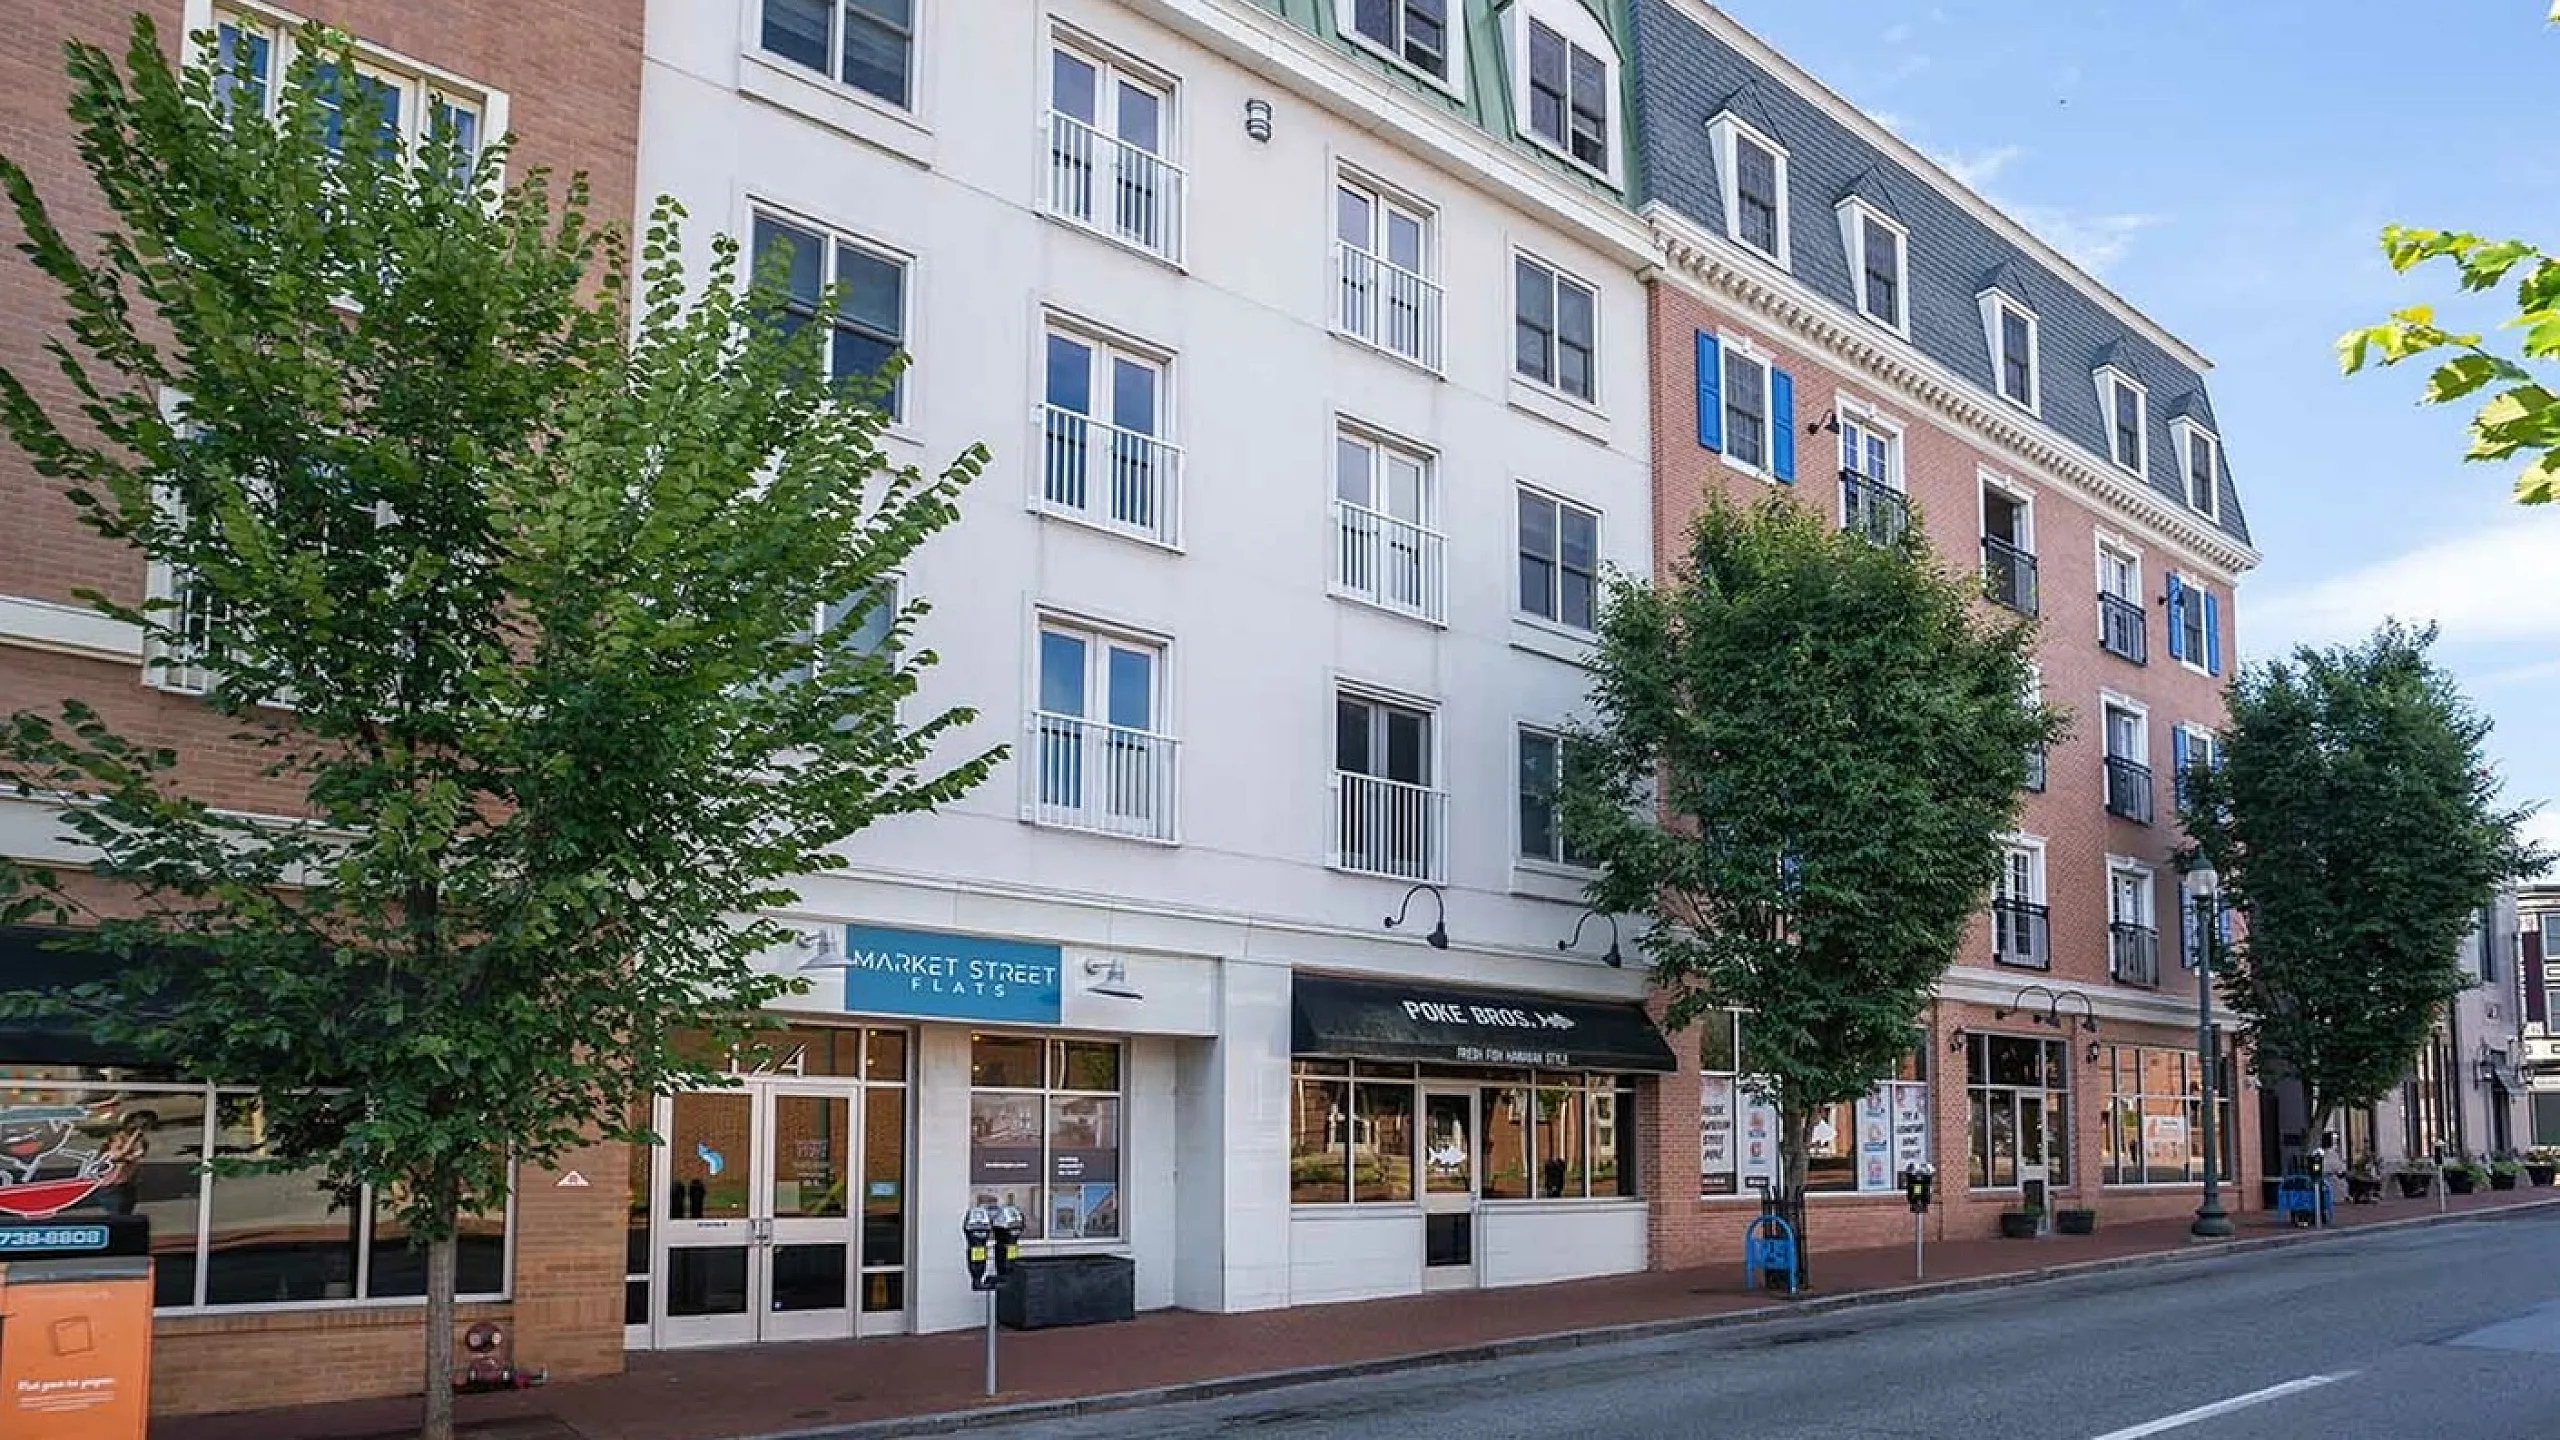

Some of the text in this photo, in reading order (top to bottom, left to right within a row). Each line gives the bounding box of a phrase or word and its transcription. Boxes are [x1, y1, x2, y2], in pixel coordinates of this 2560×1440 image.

[854, 949, 1056, 985] MARKET STREET
[911, 976, 1006, 998] FLATS
[1402, 1000, 1537, 1029] POKE BROS.
